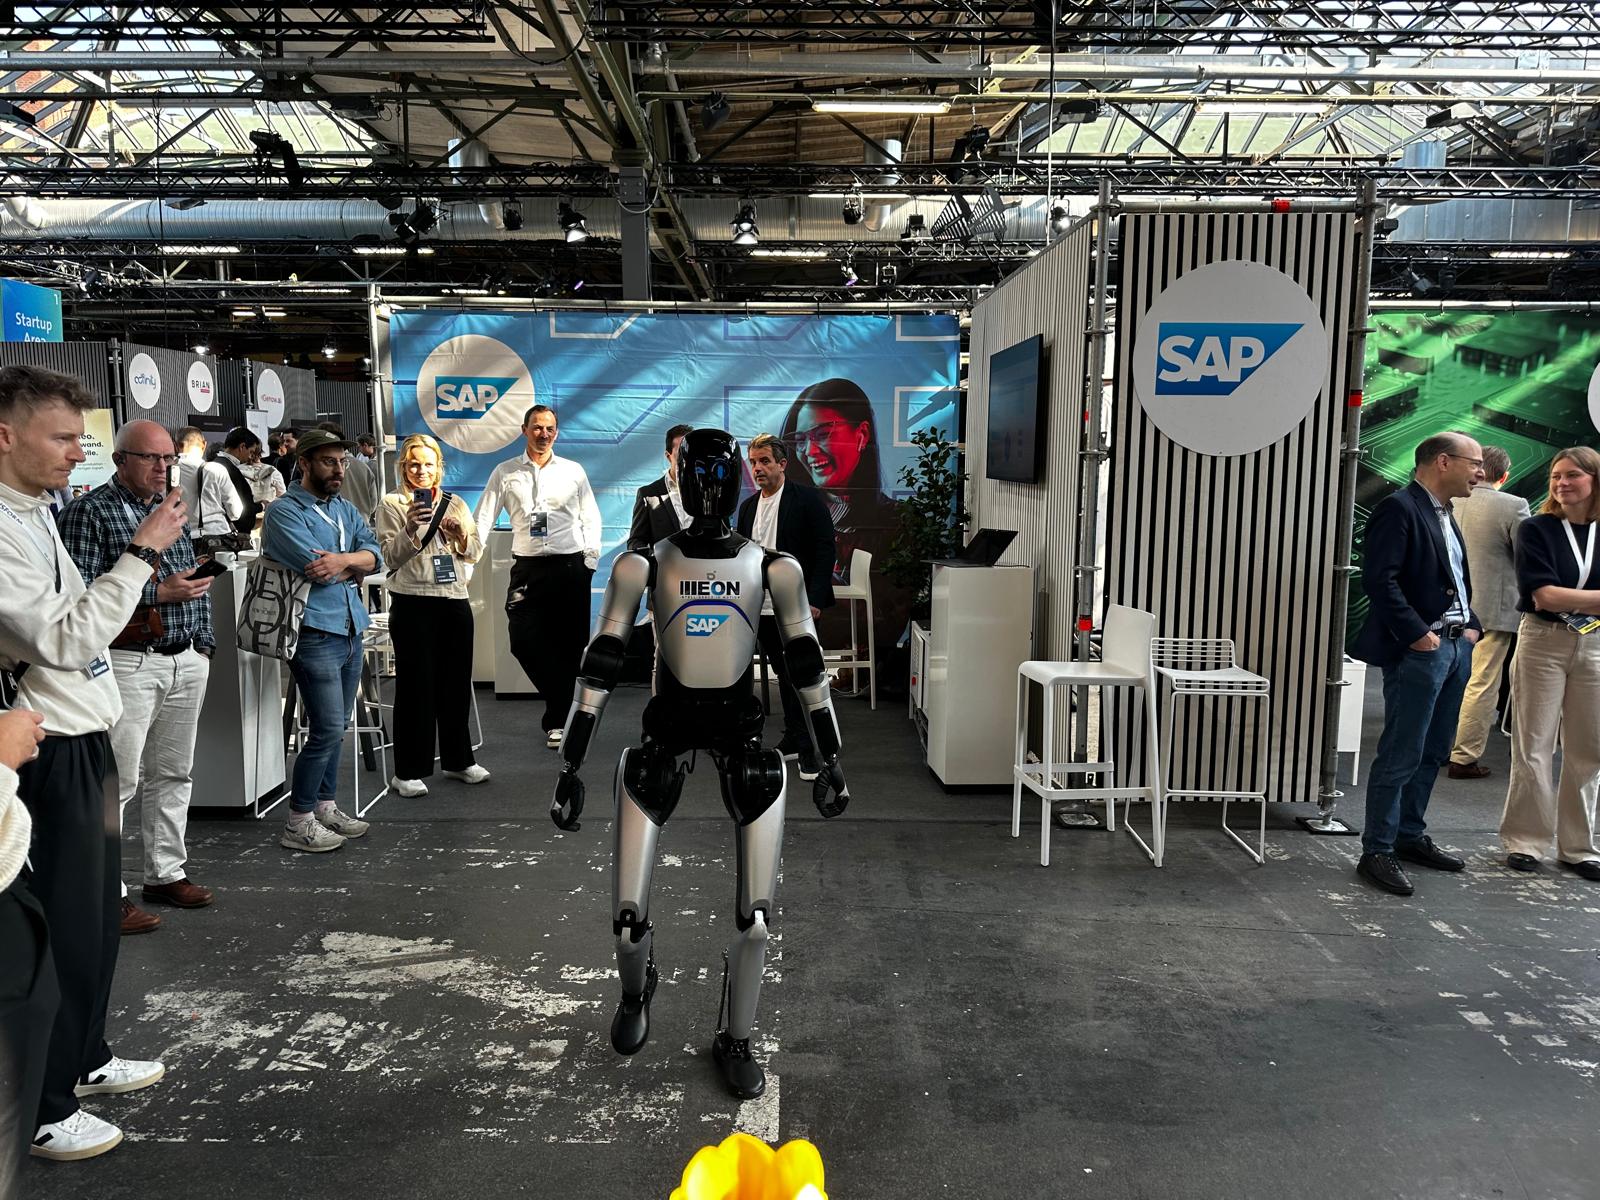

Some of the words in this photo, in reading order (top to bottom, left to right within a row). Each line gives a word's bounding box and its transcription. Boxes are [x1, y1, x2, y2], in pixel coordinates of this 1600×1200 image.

[15, 311, 53, 335] Startup
[1157, 335, 1265, 382] SAP
[191, 379, 210, 388] BRIAN
[436, 383, 499, 412] SAP
[686, 617, 720, 633] SAP
